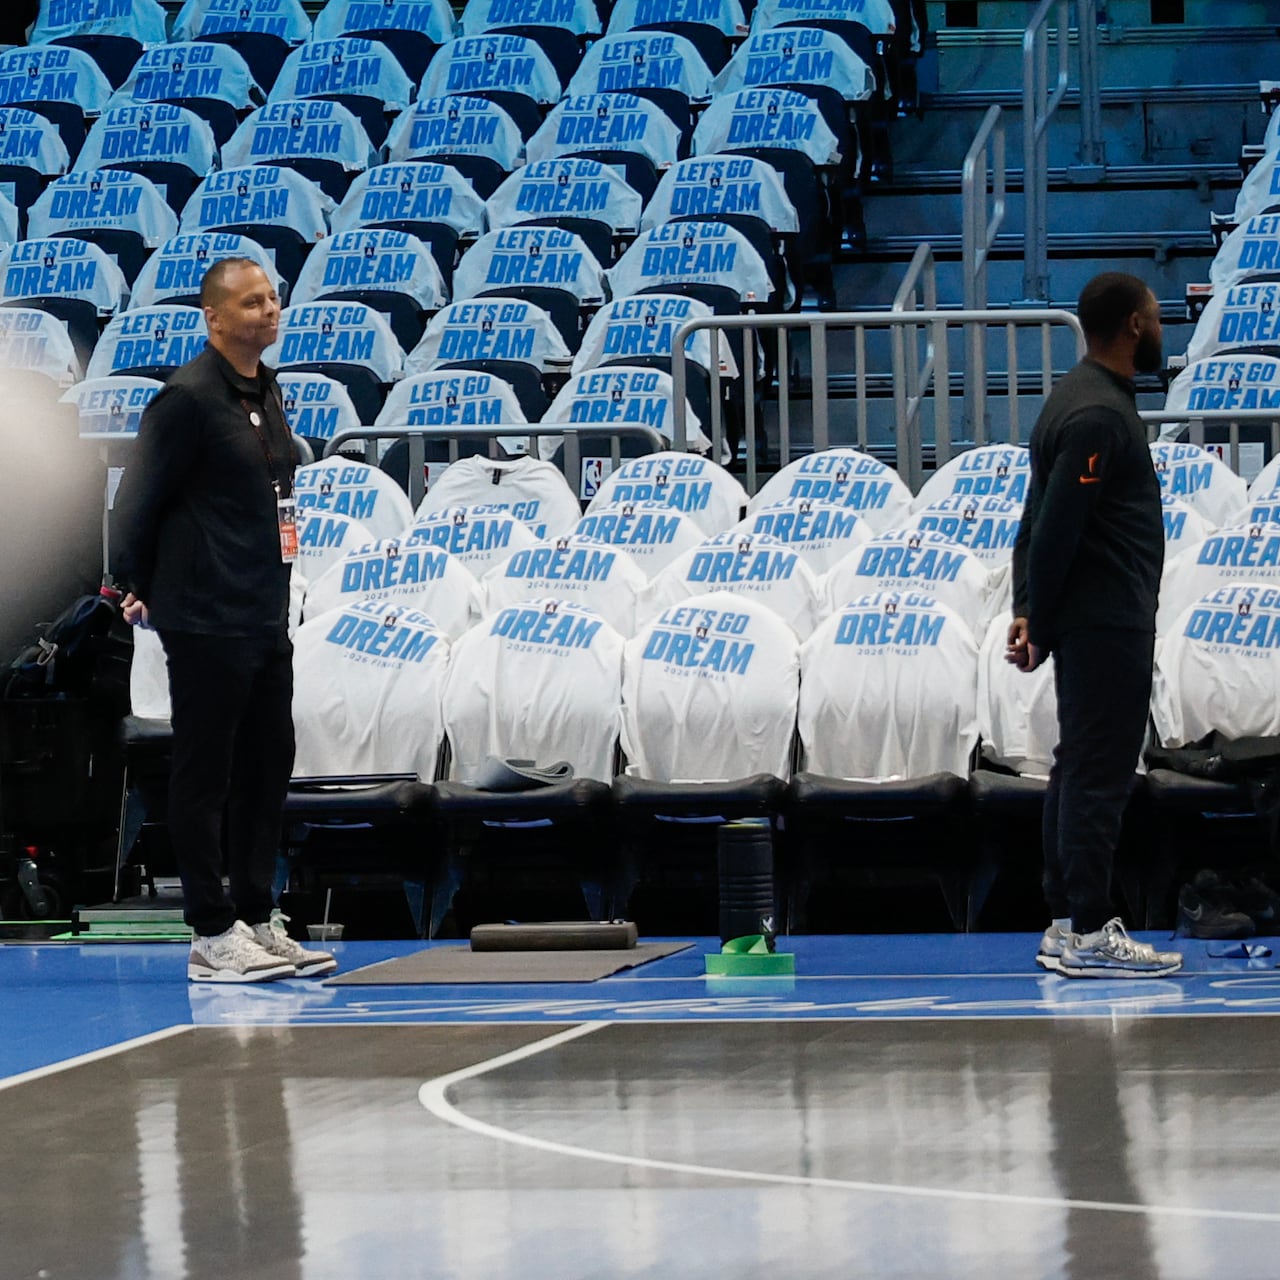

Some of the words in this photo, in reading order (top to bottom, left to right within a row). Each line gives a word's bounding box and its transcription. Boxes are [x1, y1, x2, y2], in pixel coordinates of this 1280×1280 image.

[453, 37, 498, 57] LET'S
[499, 36, 526, 54] GO
[750, 31, 795, 51] LET'S
[796, 28, 824, 48] GO
[43, 50, 69, 67] GO
[447, 57, 536, 90] DREAM
[745, 51, 834, 85] DREAM
[106, 105, 152, 126] LET'S
[155, 104, 181, 121] GO
[727, 113, 816, 143] DREAM
[102, 126, 190, 159] DREAM
[368, 166, 415, 186] LET'S
[418, 165, 441, 183] GO
[676, 163, 726, 182] LET'S
[728, 160, 753, 176] GO
[361, 188, 452, 219] DREAM
[670, 182, 762, 215] DREAM
[11, 240, 60, 262] LET'S
[61, 240, 88, 257] GO
[495, 229, 545, 249] LET'S
[547, 229, 574, 247] GO
[4, 262, 97, 297] DREAM
[486, 253, 582, 284] DREAM
[288, 306, 337, 327] LET'S
[340, 306, 367, 324] GO
[448, 304, 496, 324] LET'S
[499, 304, 528, 322] GO
[279, 330, 375, 363] DREAM
[438, 328, 535, 360] DREAM
[1193, 363, 1242, 382] LET'S
[1246, 363, 1275, 382] GO
[798, 455, 851, 474] LET'S
[856, 457, 887, 475] GO
[341, 549, 449, 593] DREAM
[505, 549, 617, 581] DREAM
[687, 552, 797, 582] DREAM
[856, 547, 967, 582] DREAM
[490, 609, 603, 649] DREAM
[658, 608, 715, 629] LET'S
[716, 614, 750, 634] GO
[834, 613, 946, 646] DREAM
[326, 615, 437, 663] DREAM
[642, 631, 755, 676] DREAM
